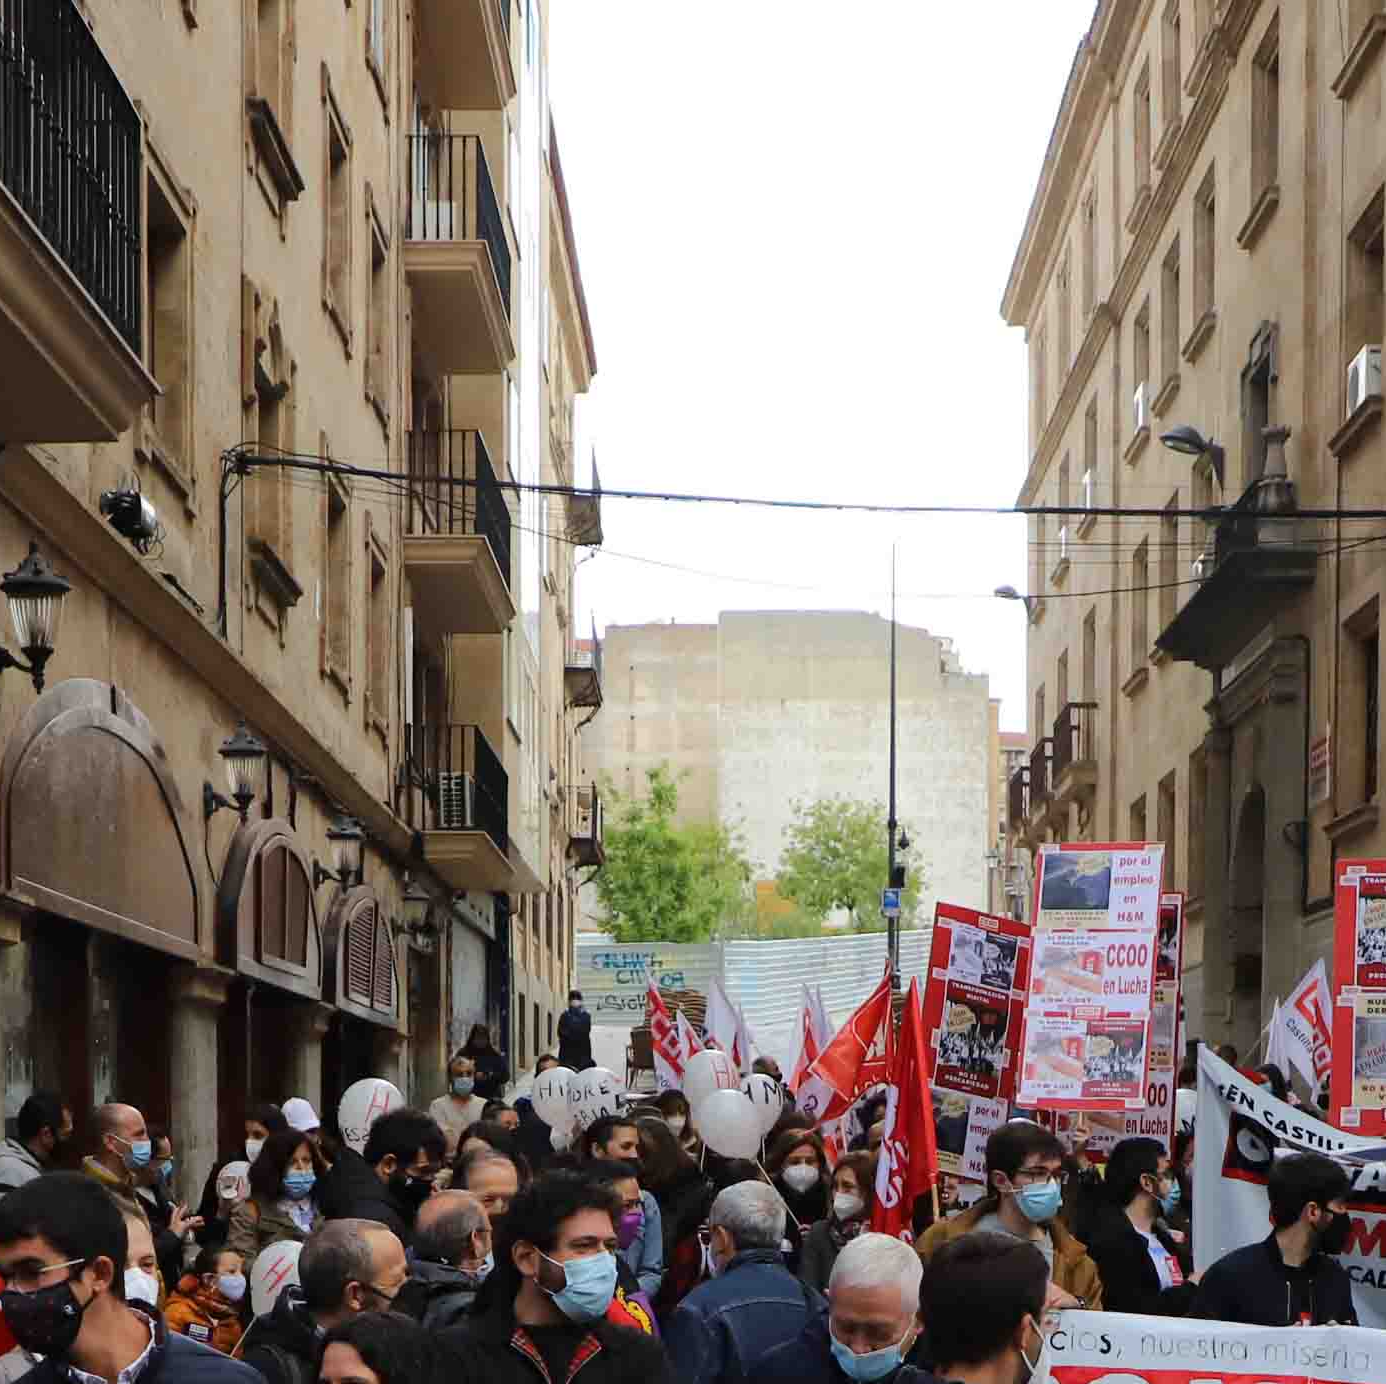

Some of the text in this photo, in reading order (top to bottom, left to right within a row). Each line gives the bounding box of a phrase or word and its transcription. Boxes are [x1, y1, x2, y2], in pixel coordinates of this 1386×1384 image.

[1119, 856, 1138, 867] por
[1106, 943, 1148, 968] CCOO
[1103, 975, 1148, 995] en Lucha
[975, 1105, 990, 1116] por
[1125, 1115, 1168, 1136] en Lucha
[1049, 1325, 1372, 1373] cios, nuestra miseria
